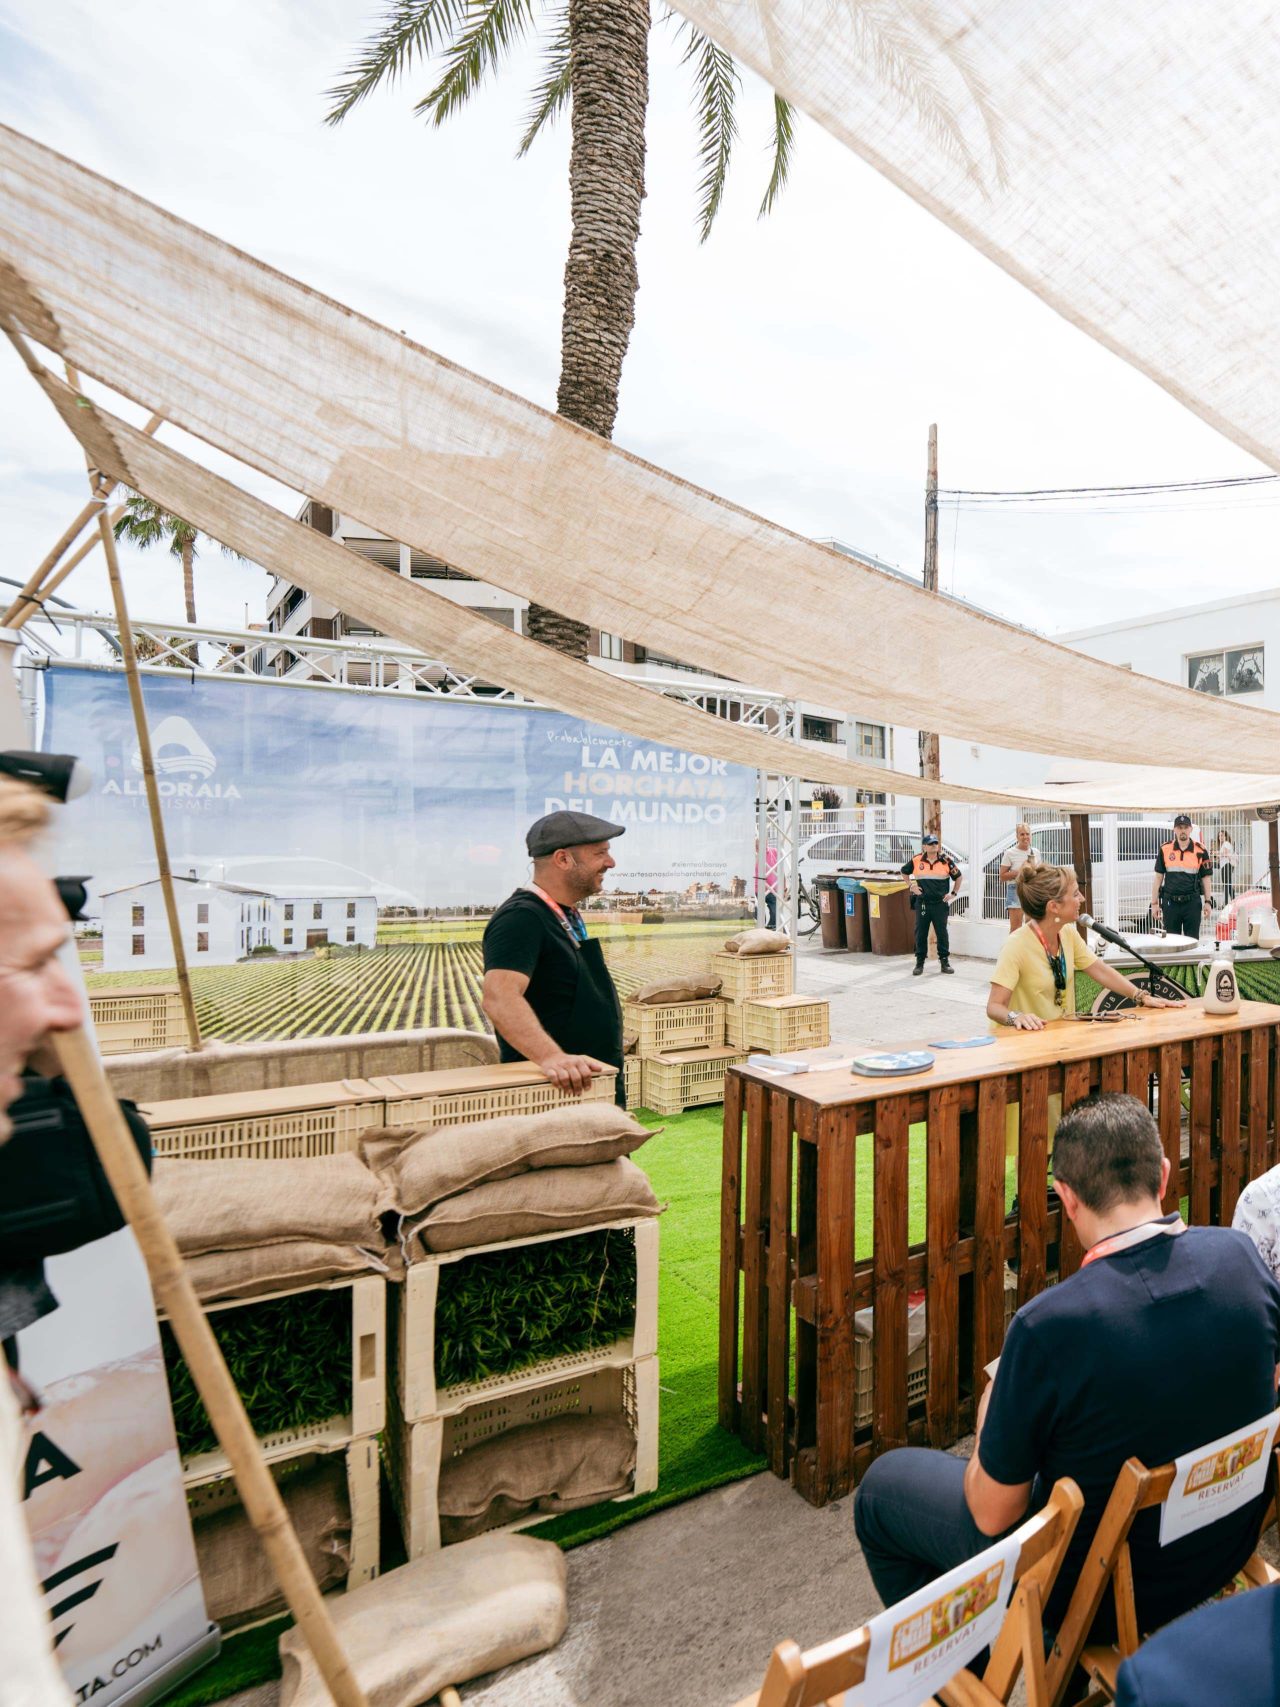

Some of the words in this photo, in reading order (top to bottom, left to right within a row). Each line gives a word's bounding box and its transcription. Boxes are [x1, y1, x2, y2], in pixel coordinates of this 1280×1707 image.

[548, 731, 633, 748] Probablemente
[582, 746, 620, 769] LA
[632, 750, 728, 776] MEJOR
[564, 772, 726, 798] HORCHATA
[610, 801, 726, 824] MUNDO
[1198, 1472, 1246, 1500] RESERVAT
[913, 1621, 977, 1674] RESERVAT
